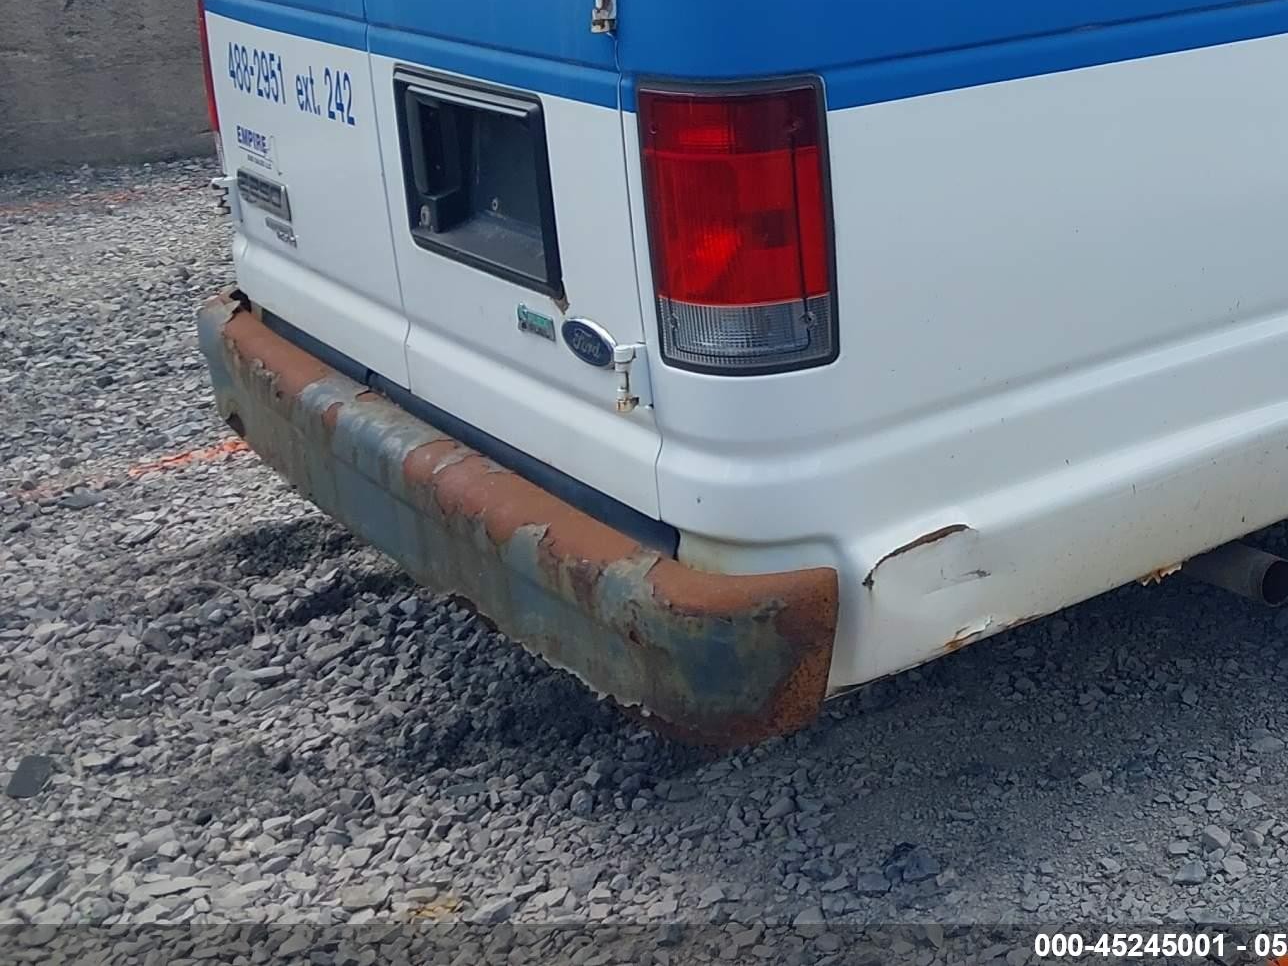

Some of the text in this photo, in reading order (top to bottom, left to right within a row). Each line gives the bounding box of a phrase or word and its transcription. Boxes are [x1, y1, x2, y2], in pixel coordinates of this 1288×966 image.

[228, 41, 356, 126] 488-2951 ext. 242
[236, 124, 268, 154] EMPIRE
[572, 327, 602, 358] Ford
